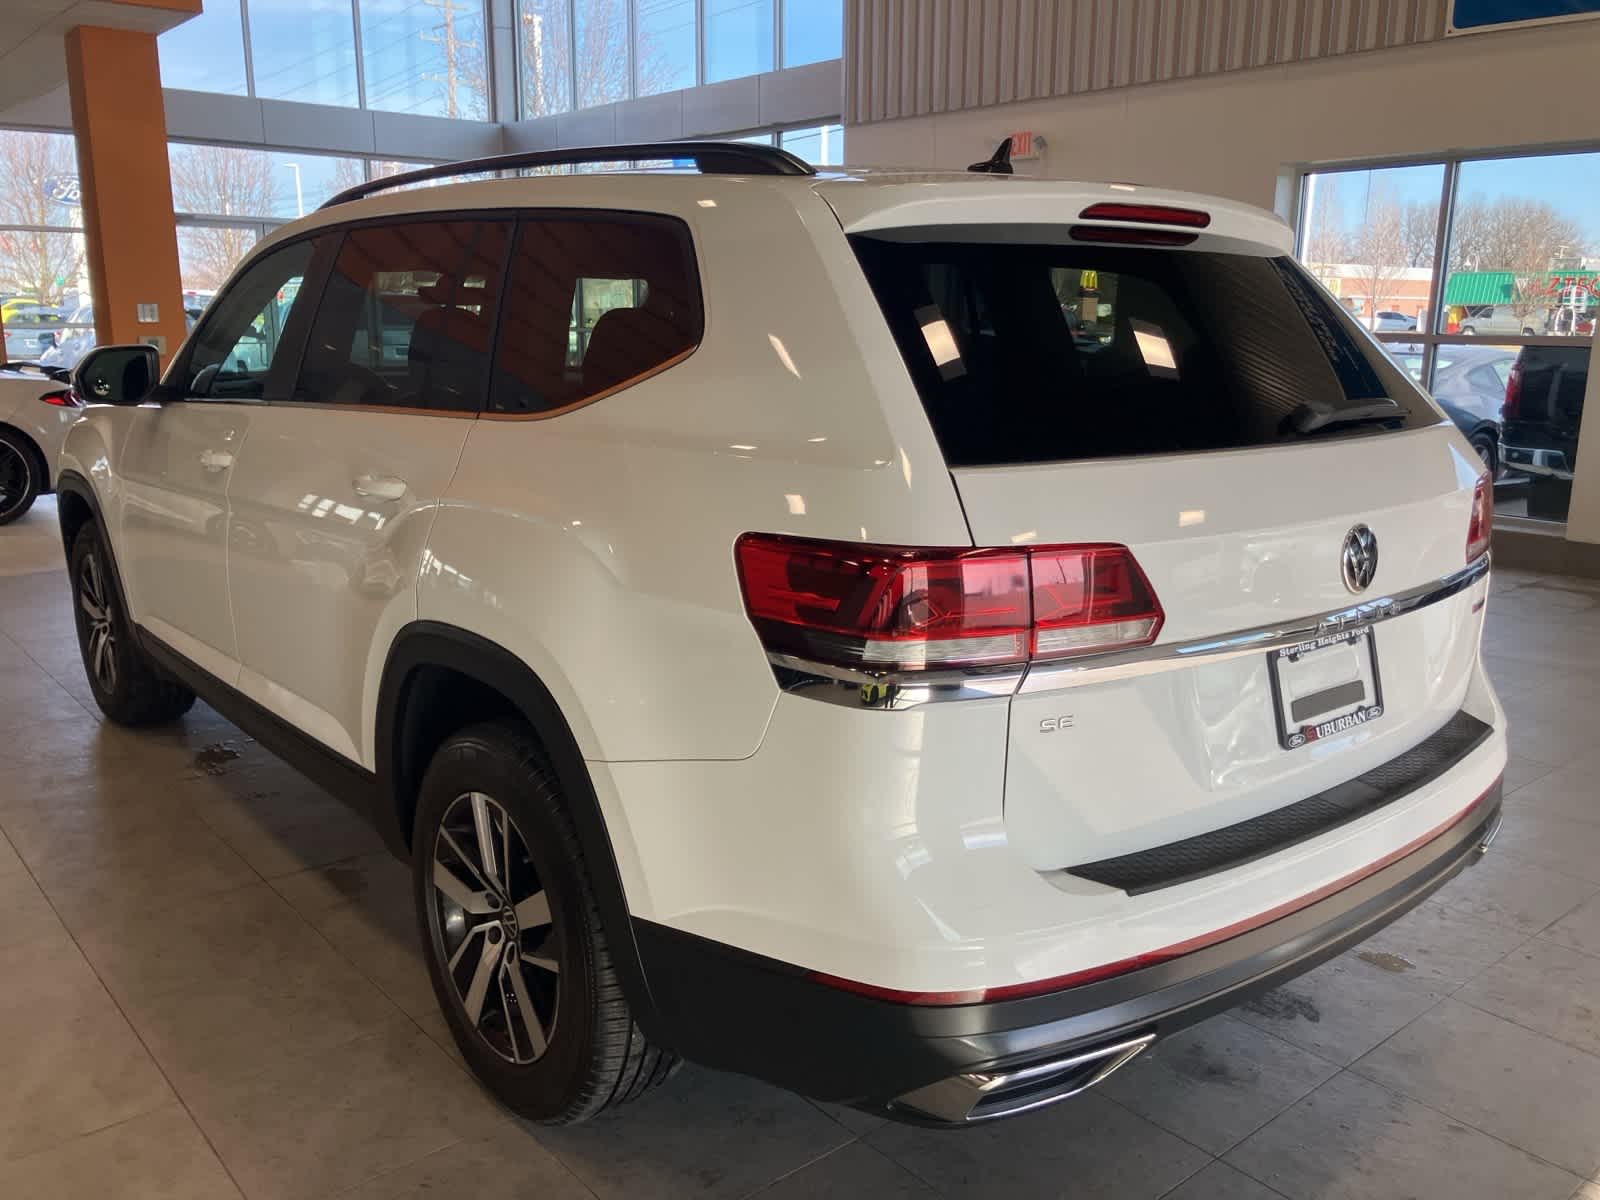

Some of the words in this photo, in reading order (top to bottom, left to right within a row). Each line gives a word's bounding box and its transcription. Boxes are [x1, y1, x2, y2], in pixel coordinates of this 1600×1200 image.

[1010, 131, 1032, 157] EXIT
[52, 179, 80, 200] Fo
[1279, 641, 1316, 657] Sterling
[1317, 631, 1349, 647] Heights
[1351, 626, 1370, 637] Ford
[1039, 714, 1073, 734] SE
[1305, 710, 1366, 743] SUBURBAN
